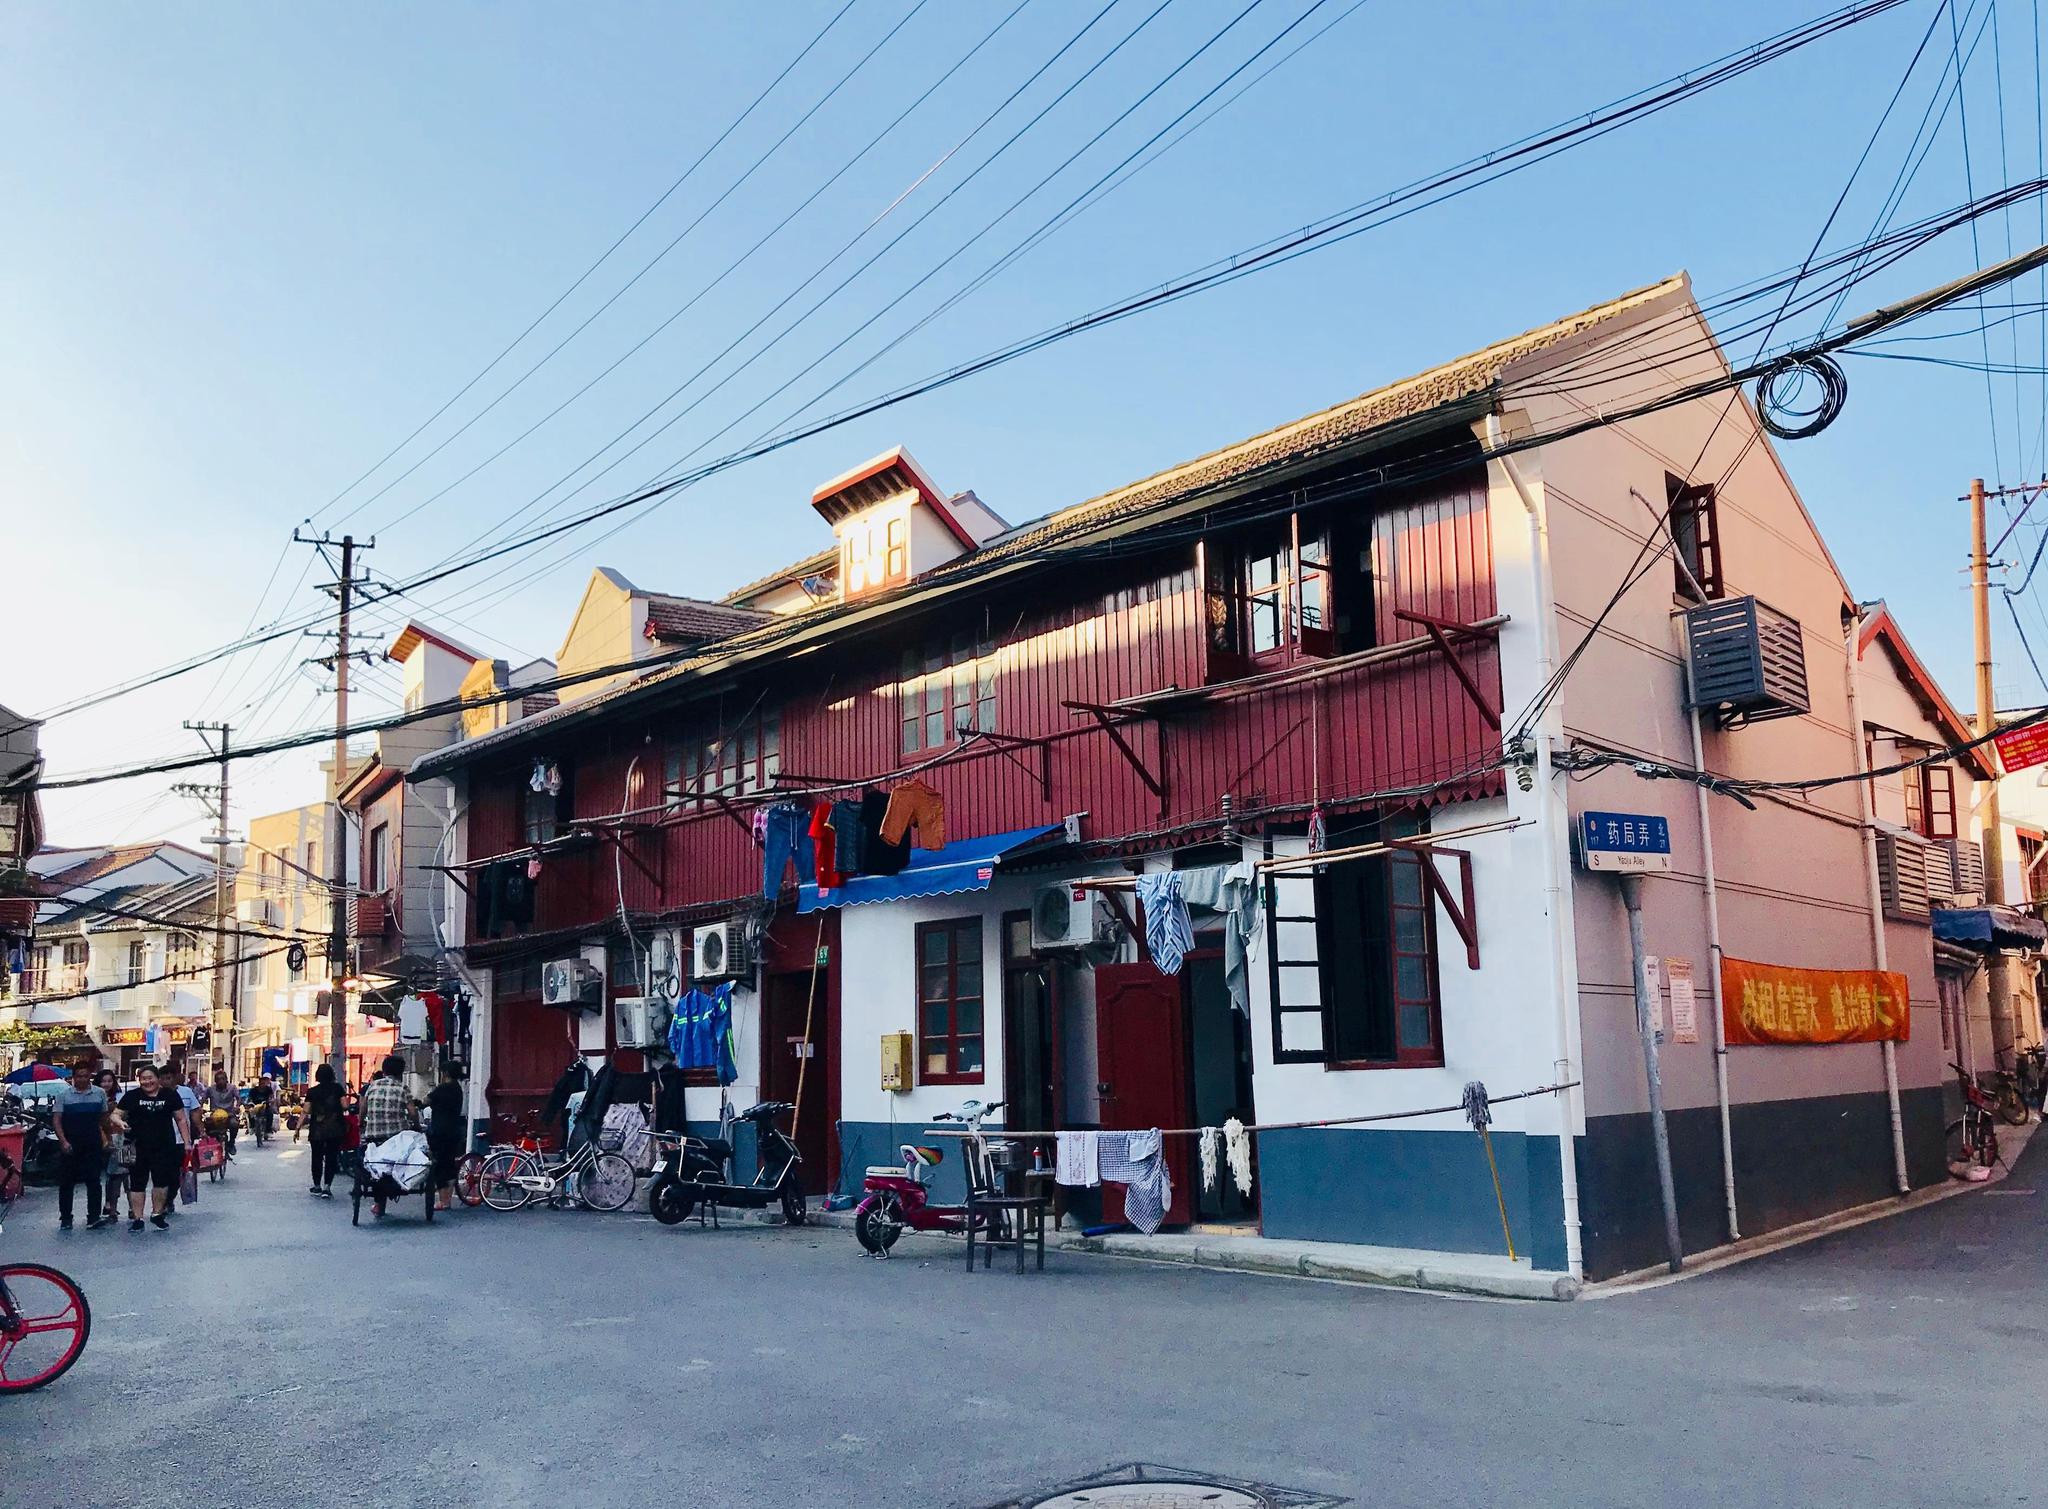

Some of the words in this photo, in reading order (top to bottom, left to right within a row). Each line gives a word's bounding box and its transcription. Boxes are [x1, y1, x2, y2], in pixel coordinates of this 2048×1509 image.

[1607, 820, 1650, 847] 药局弄
[1594, 854, 1600, 866] S
[1661, 857, 1667, 868] N
